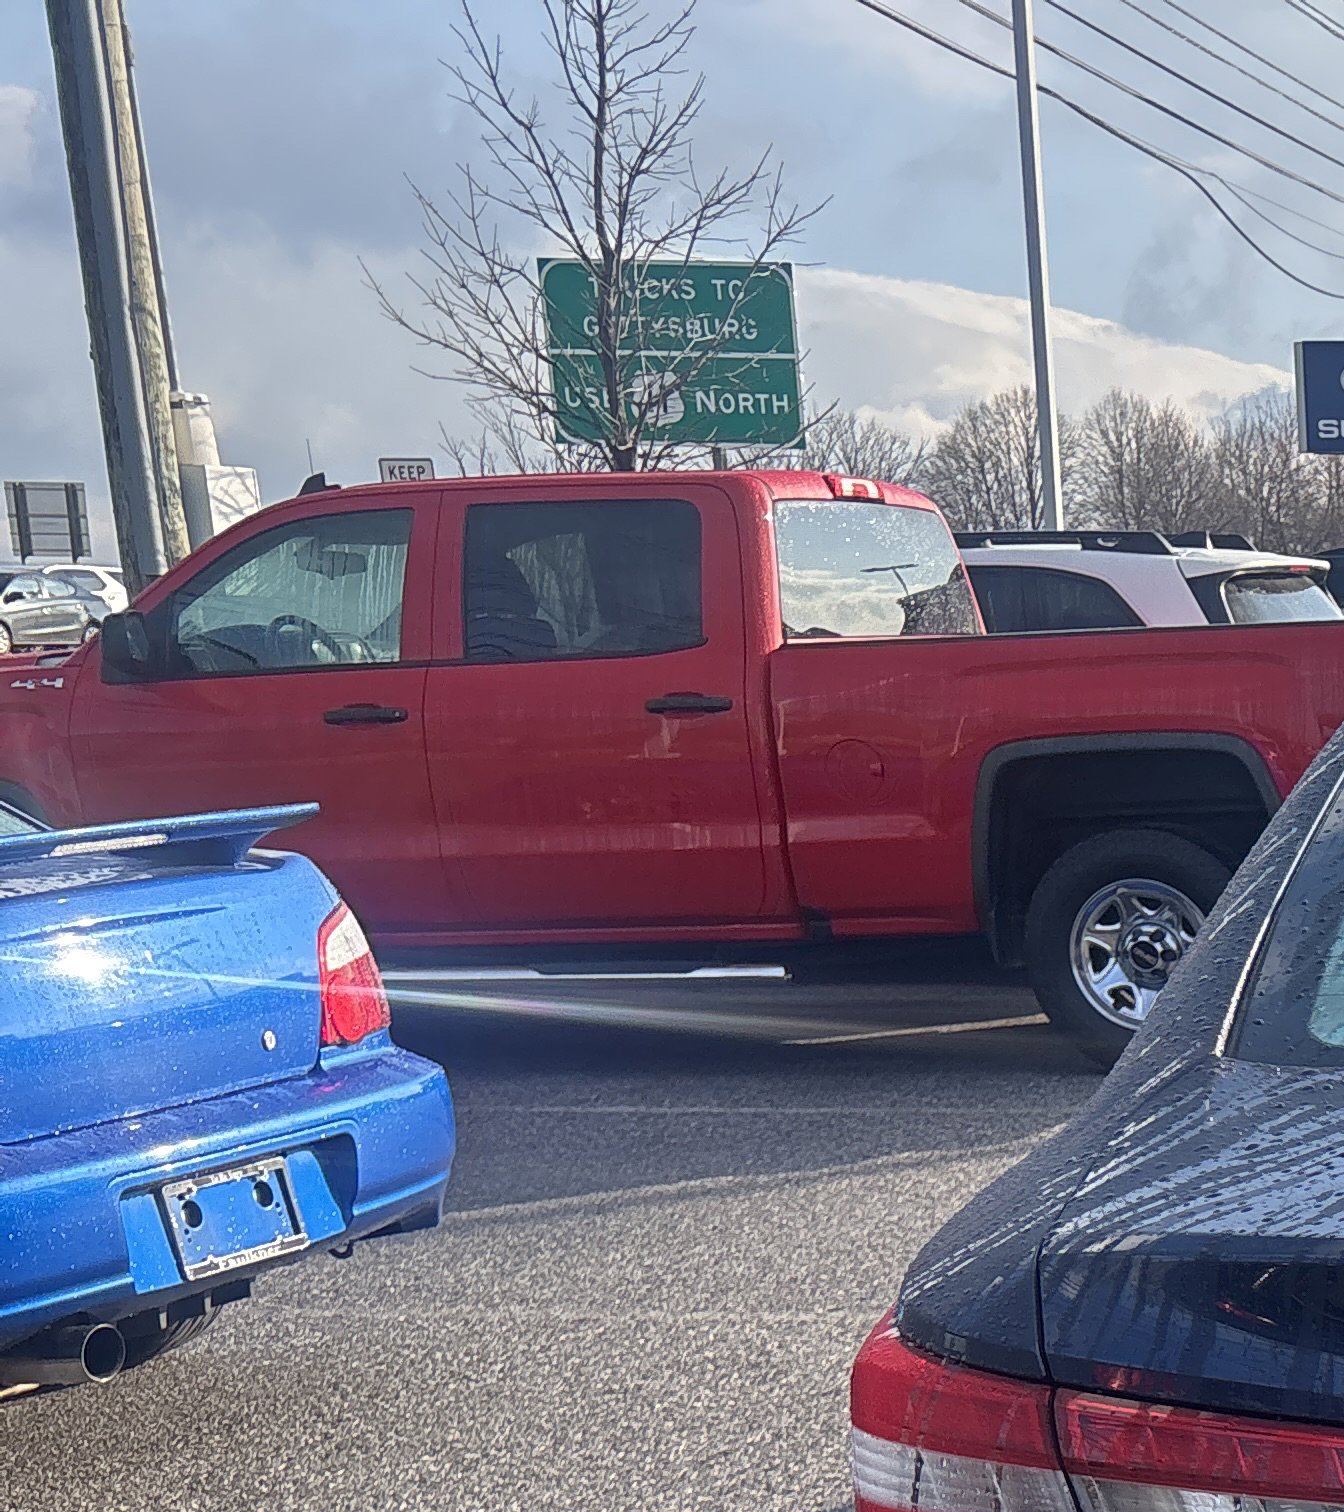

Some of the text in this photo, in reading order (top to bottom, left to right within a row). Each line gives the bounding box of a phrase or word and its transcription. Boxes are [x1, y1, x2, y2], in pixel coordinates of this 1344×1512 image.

[588, 276, 696, 300] TUCKS
[696, 391, 789, 415] NORTH
[388, 465, 426, 480] KEEP
